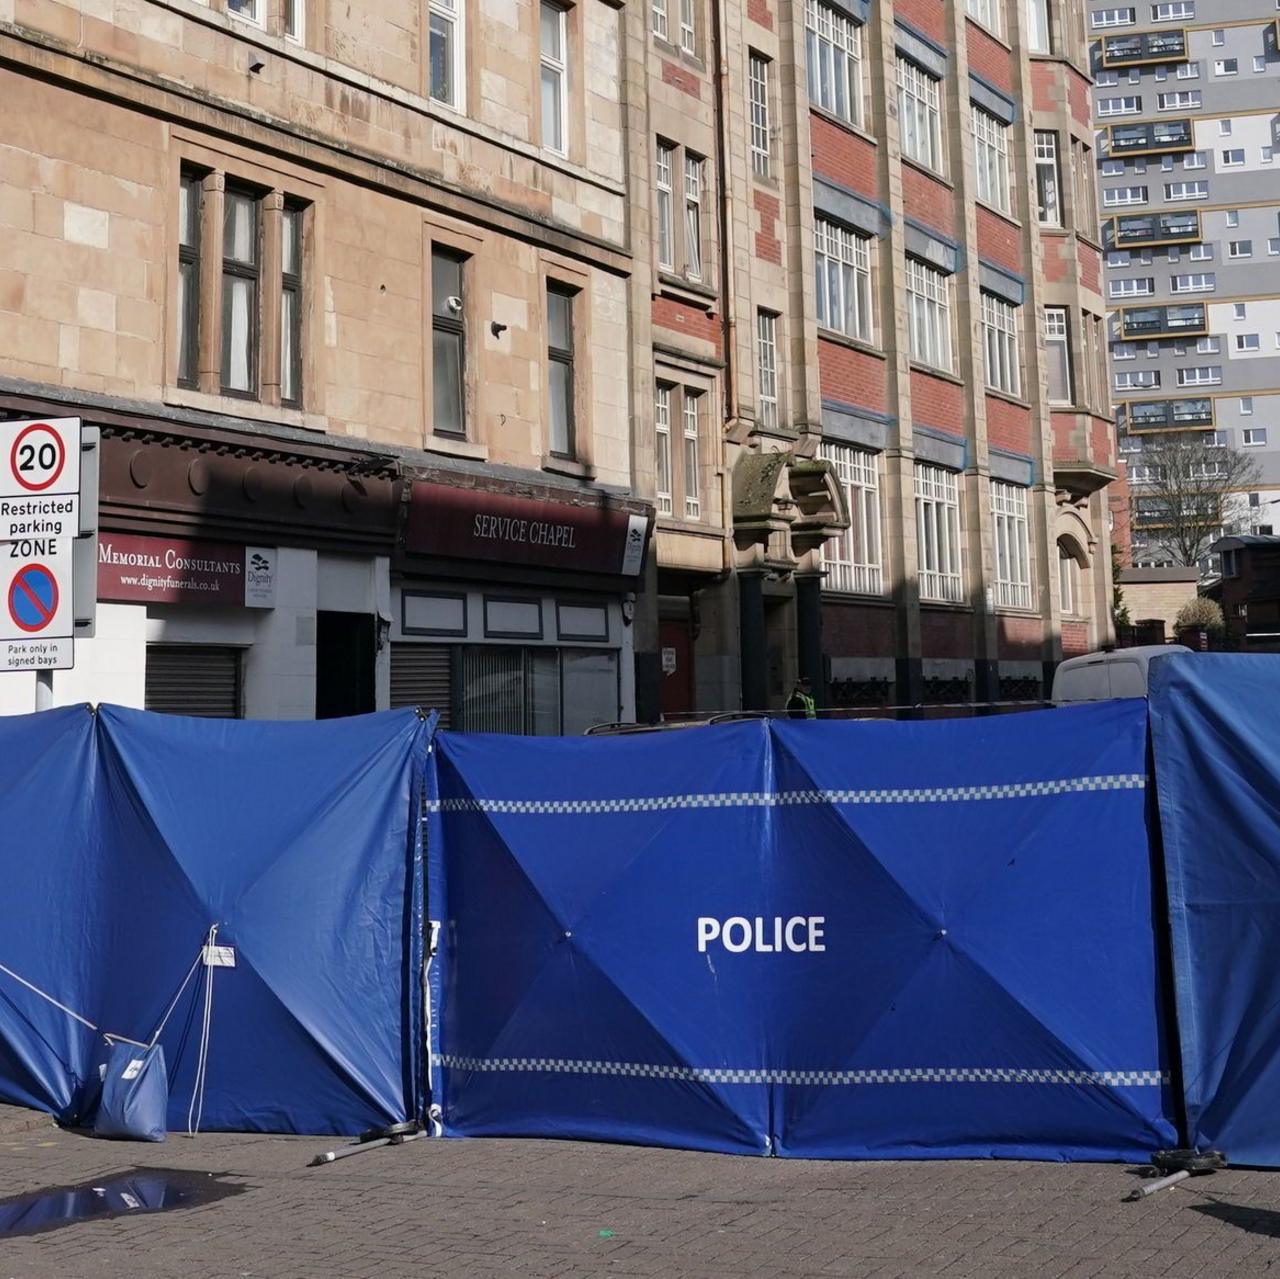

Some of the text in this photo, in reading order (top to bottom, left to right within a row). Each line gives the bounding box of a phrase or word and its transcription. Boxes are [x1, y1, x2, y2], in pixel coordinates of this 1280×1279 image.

[19, 443, 56, 471] 20
[1, 500, 73, 516] Restricted
[9, 520, 62, 535] parking
[473, 514, 576, 548] SERVICE CHAPEL
[10, 539, 57, 558] ZONE
[120, 574, 220, 592] www.dignityfunerals.co.uk
[8, 643, 58, 655] Park only in
[8, 655, 58, 667] signed bays
[697, 916, 826, 953] POLICE
